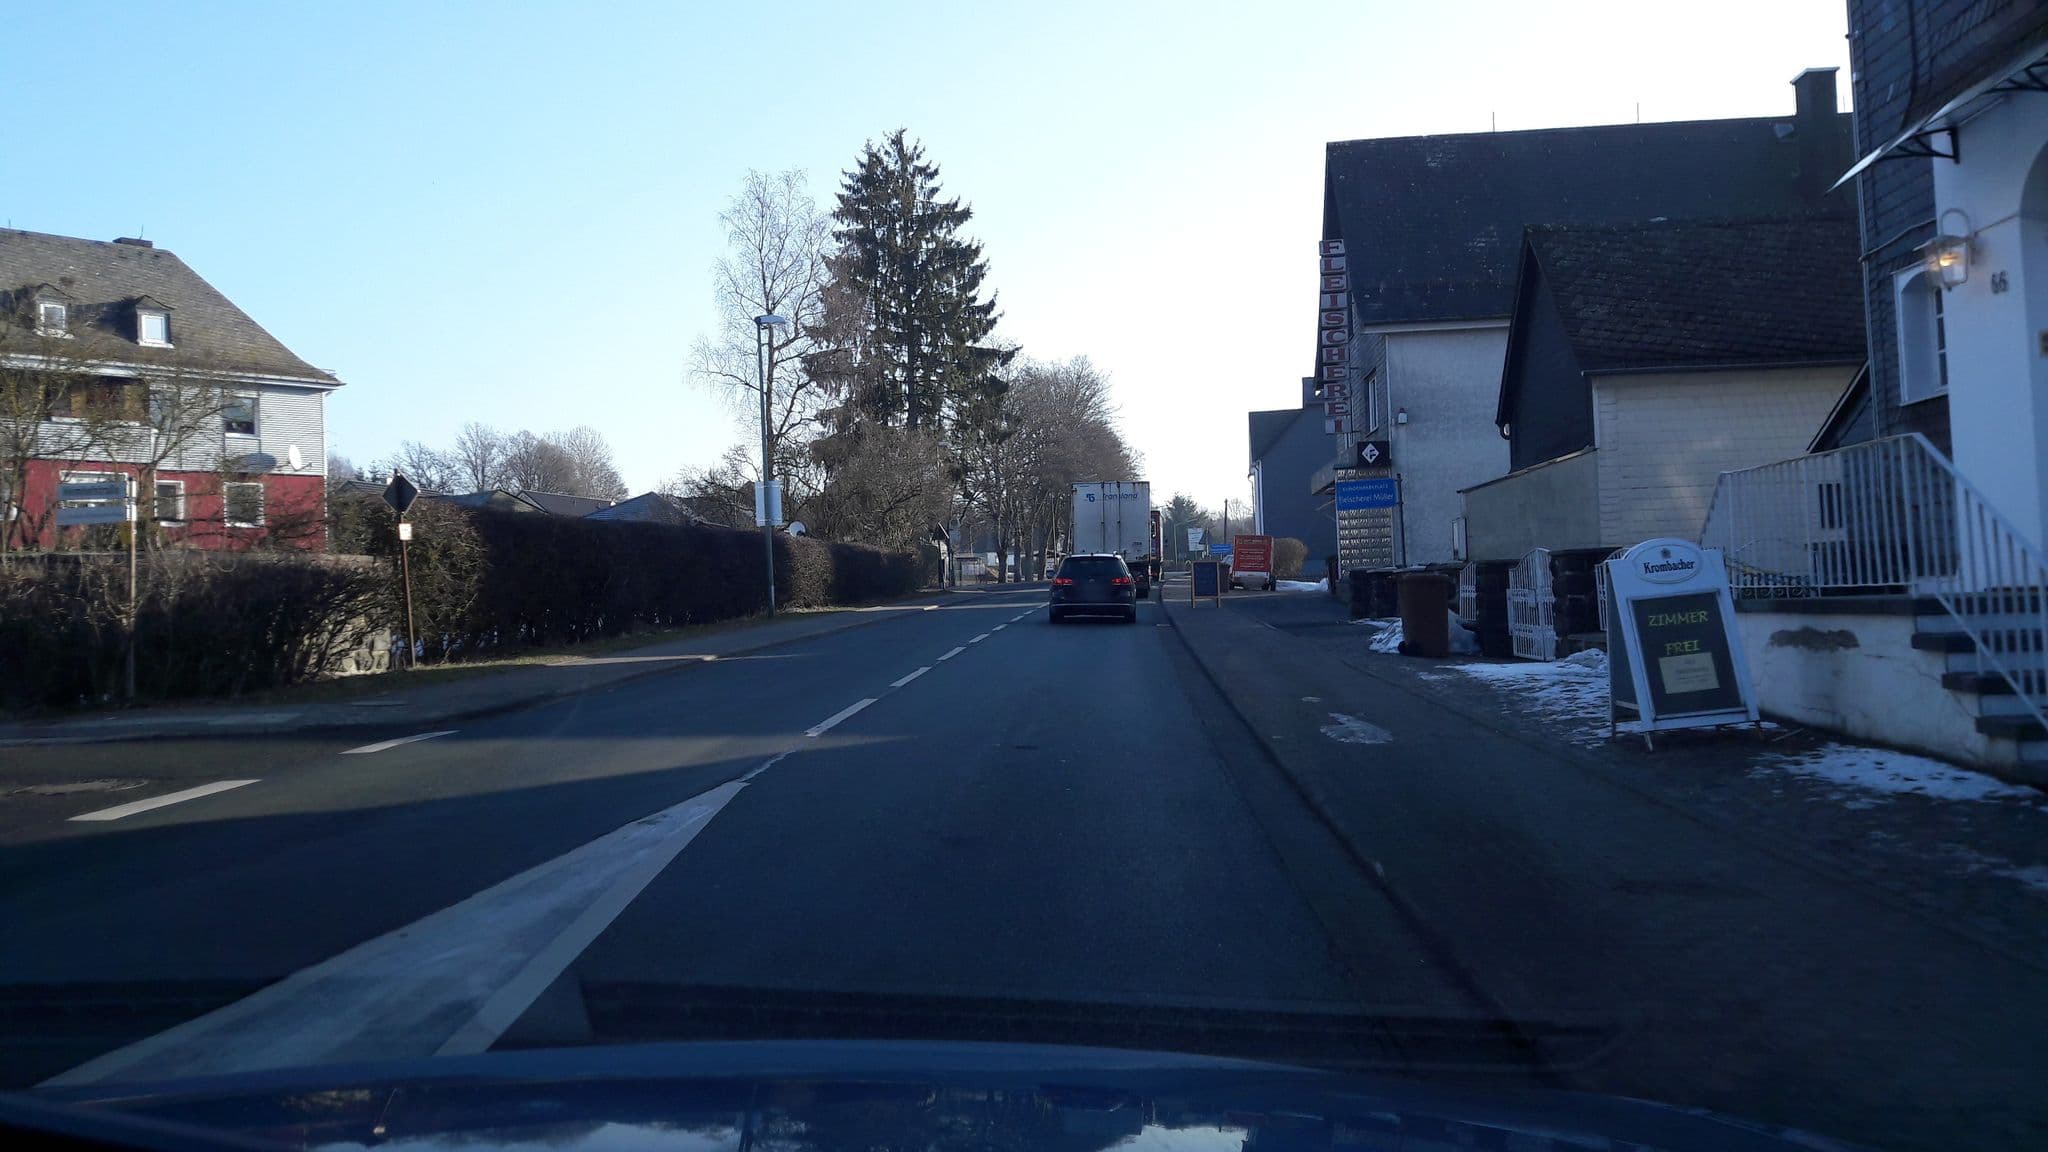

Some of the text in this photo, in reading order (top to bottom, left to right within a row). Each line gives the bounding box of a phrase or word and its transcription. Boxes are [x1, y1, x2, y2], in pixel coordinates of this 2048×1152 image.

[1991, 271, 2009, 294] 66
[1321, 240, 1349, 432] FLEISCHEREI
[1643, 560, 1695, 574] Krombacher
[1649, 610, 1709, 626] ZIMMER
[1664, 639, 1700, 656] FREI
